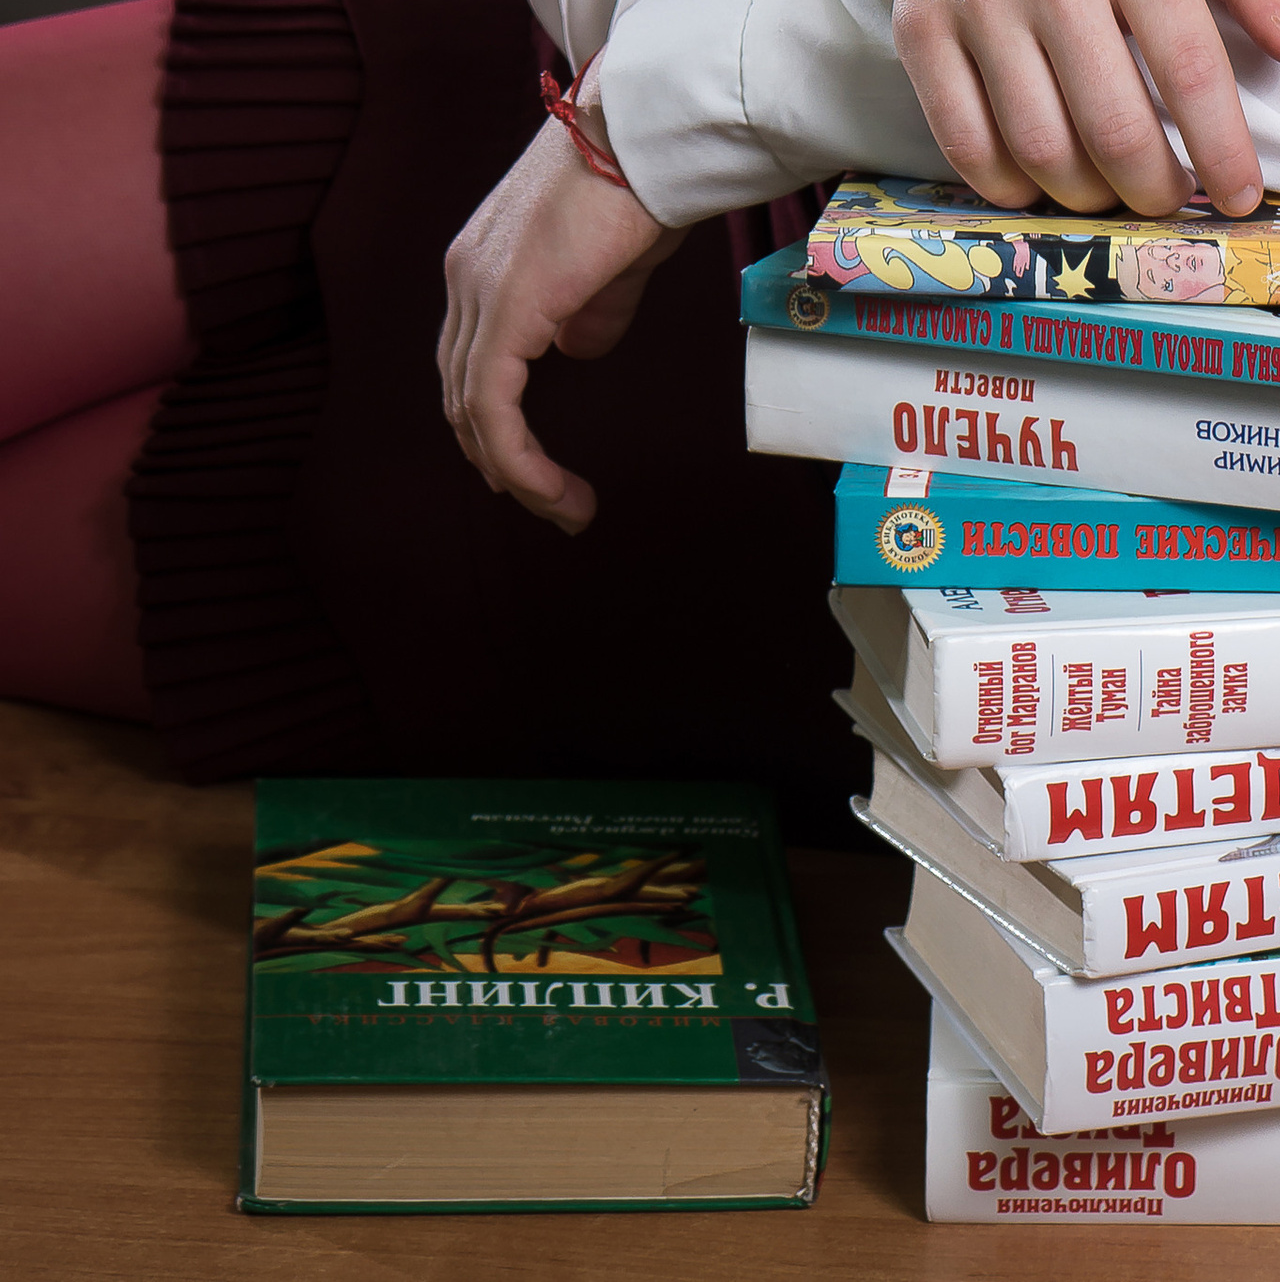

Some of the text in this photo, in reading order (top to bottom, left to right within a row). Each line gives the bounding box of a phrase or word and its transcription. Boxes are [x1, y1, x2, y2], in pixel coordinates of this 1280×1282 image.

[853, 294, 993, 348] САМОДЕЛКИНА
[1000, 315, 1016, 345] И
[1022, 314, 1144, 365] КАРАНДАША
[1152, 330, 1223, 375] ШКОЛА
[892, 401, 1079, 474] ЧУЧЕЛО
[960, 520, 1119, 560] ПОВЕСТИ
[970, 660, 1004, 745] Огненный
[1004, 641, 1040, 756] бог Марранов
[1061, 661, 1094, 733] Жёлтый
[1094, 668, 1129, 724] Туман
[1150, 666, 1183, 719] Тайна
[1182, 630, 1216, 745] заброшенного
[1220, 661, 1249, 714] замка
[306, 1014, 721, 1027] МИРОВАЯ КЛАССИКА
[376, 981, 794, 1010] Р. КИПЛИНГ
[1112, 1082, 1273, 1118] Приключения
[966, 1147, 1197, 1198] Оливера
[996, 1197, 1163, 1216] Приключения
